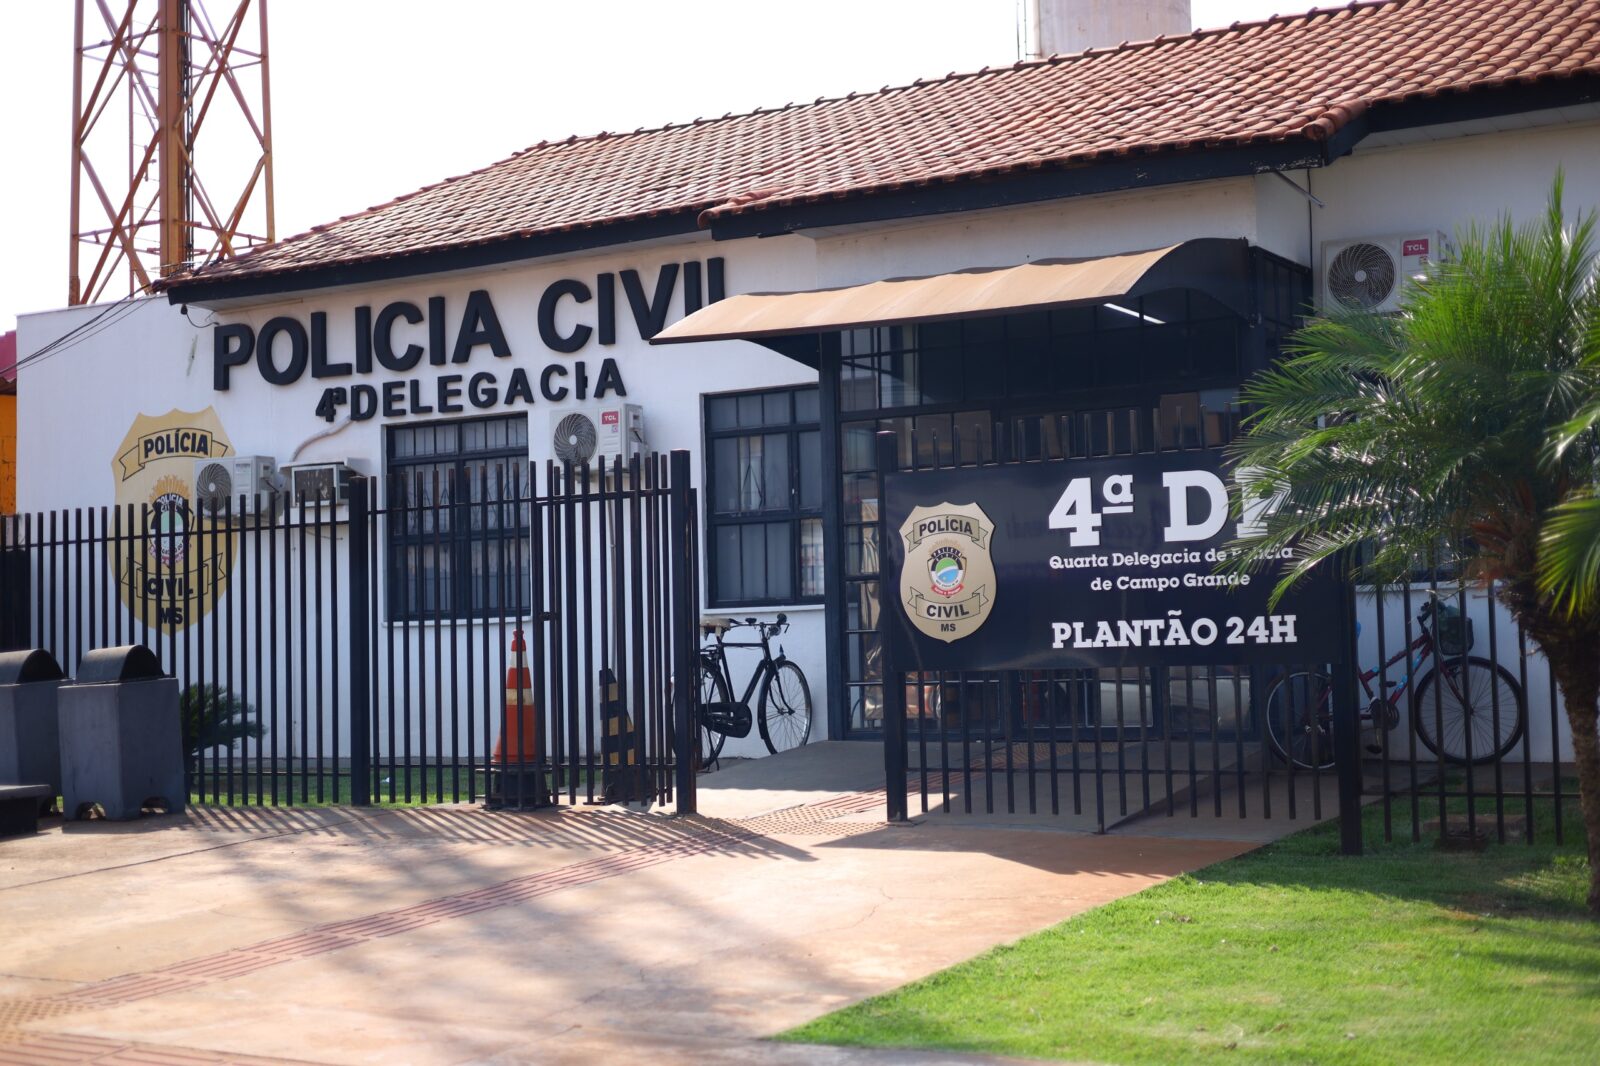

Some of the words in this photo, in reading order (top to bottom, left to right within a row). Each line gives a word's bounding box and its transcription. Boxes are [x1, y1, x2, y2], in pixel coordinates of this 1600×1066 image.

[1406, 243, 1425, 251] TCL
[213, 289, 511, 391] POLICIA
[350, 358, 627, 421] DELEGACIA
[143, 429, 209, 458] POLÍCIA
[1048, 474, 1134, 547] 4ª
[919, 516, 973, 536] POLÍCIA
[1049, 554, 1109, 570] Quarta
[1112, 548, 1201, 568] Delegacia
[1204, 547, 1228, 562] de
[1090, 577, 1113, 591] de
[1116, 575, 1181, 592] Campo
[1183, 571, 1251, 588] Grande
[926, 604, 970, 618] CIVIL
[940, 623, 957, 632] MS
[1052, 609, 1218, 649] PLANTÃO
[1226, 614, 1298, 645] 24H
